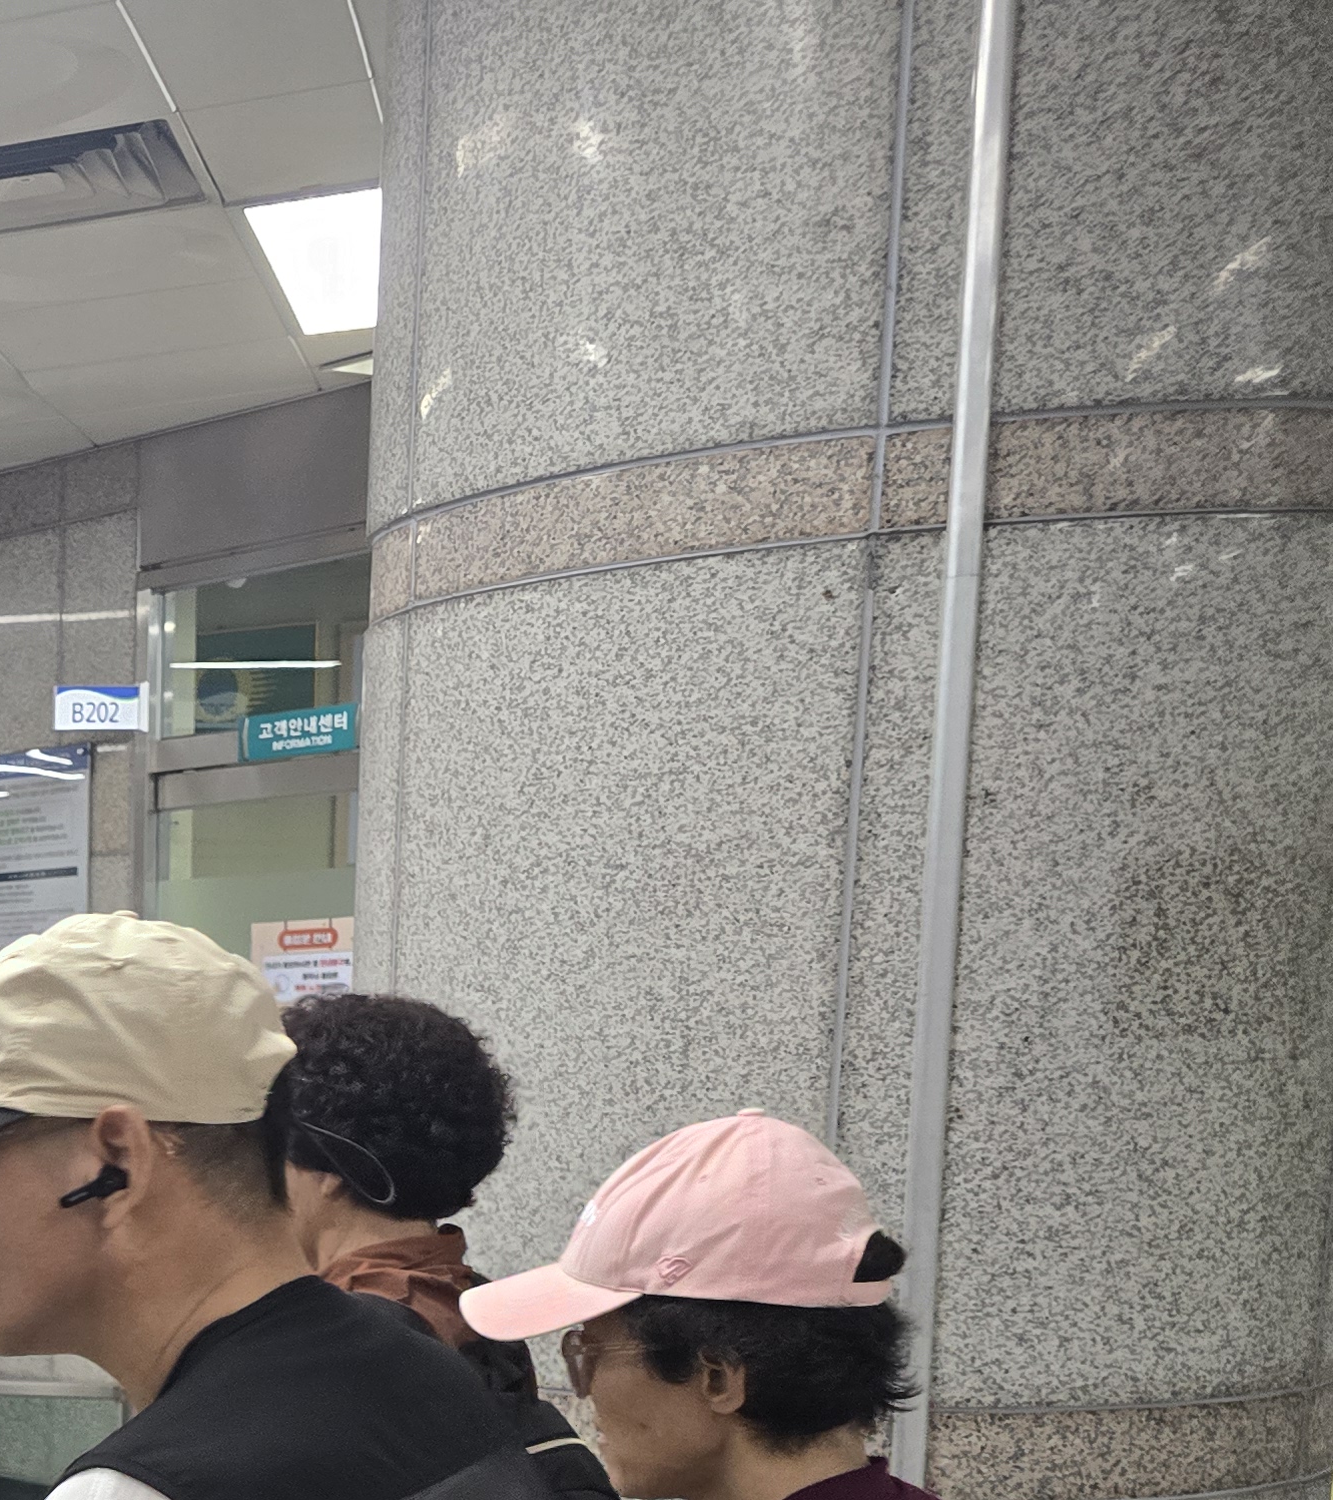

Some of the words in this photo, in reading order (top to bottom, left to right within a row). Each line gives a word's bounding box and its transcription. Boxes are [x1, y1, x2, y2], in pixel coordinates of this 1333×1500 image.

[71, 701, 120, 724] B202
[258, 710, 348, 739] 고객안내센터
[272, 734, 332, 751] INFORMATION
